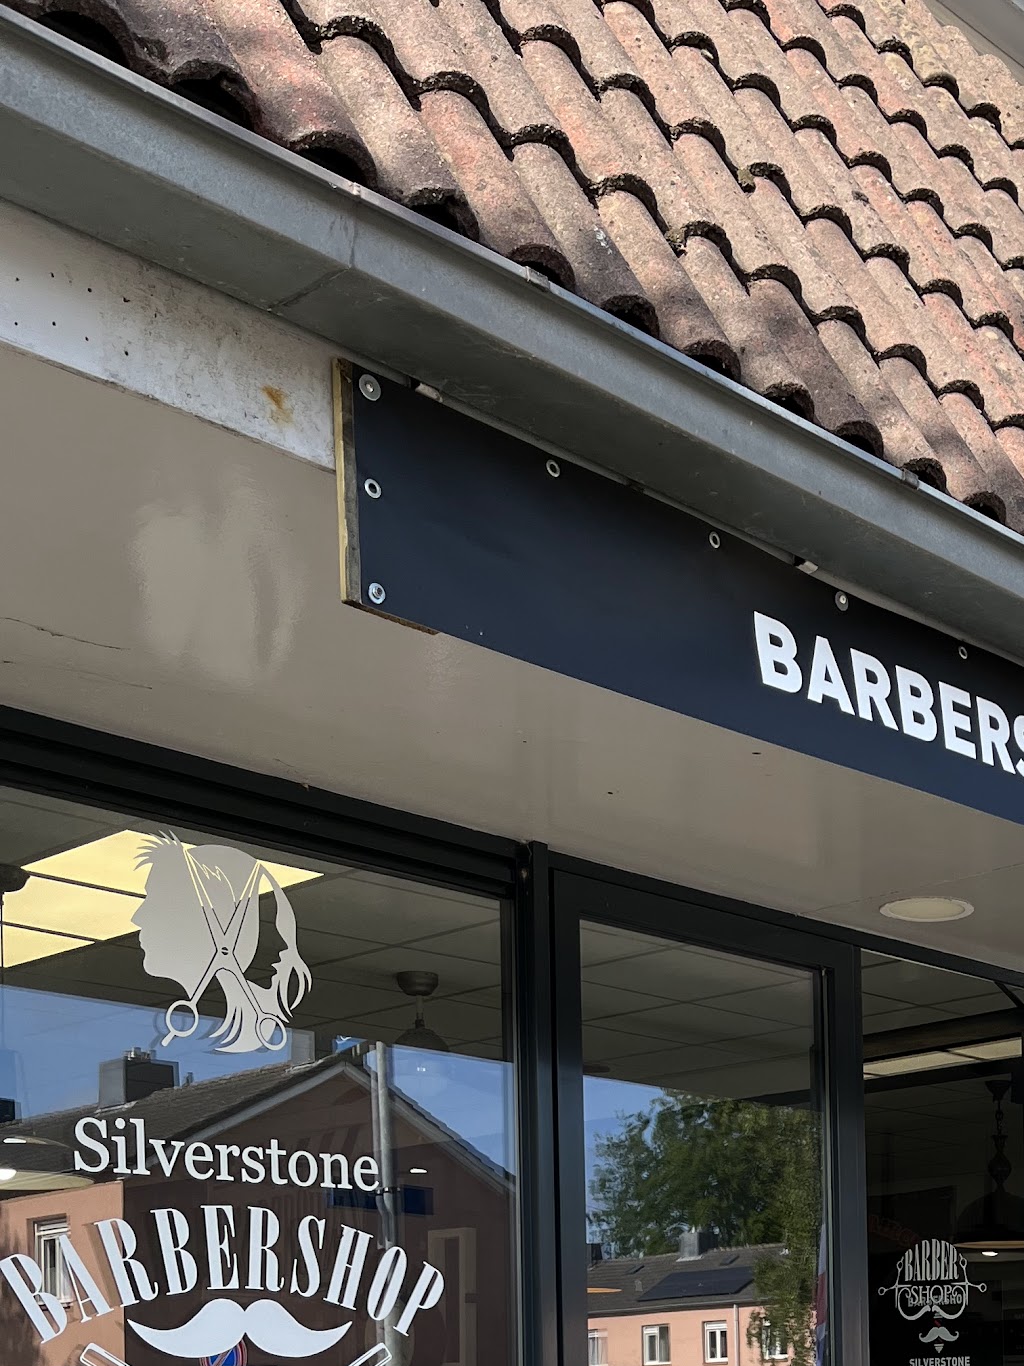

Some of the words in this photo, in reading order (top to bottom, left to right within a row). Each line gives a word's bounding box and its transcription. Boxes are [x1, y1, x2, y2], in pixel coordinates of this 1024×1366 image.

[73, 1117, 381, 1192] Silverstone
[0, 1204, 445, 1344] BARBERSHOP
[904, 1238, 960, 1282] BARBER
[911, 1285, 953, 1304] SHOP
